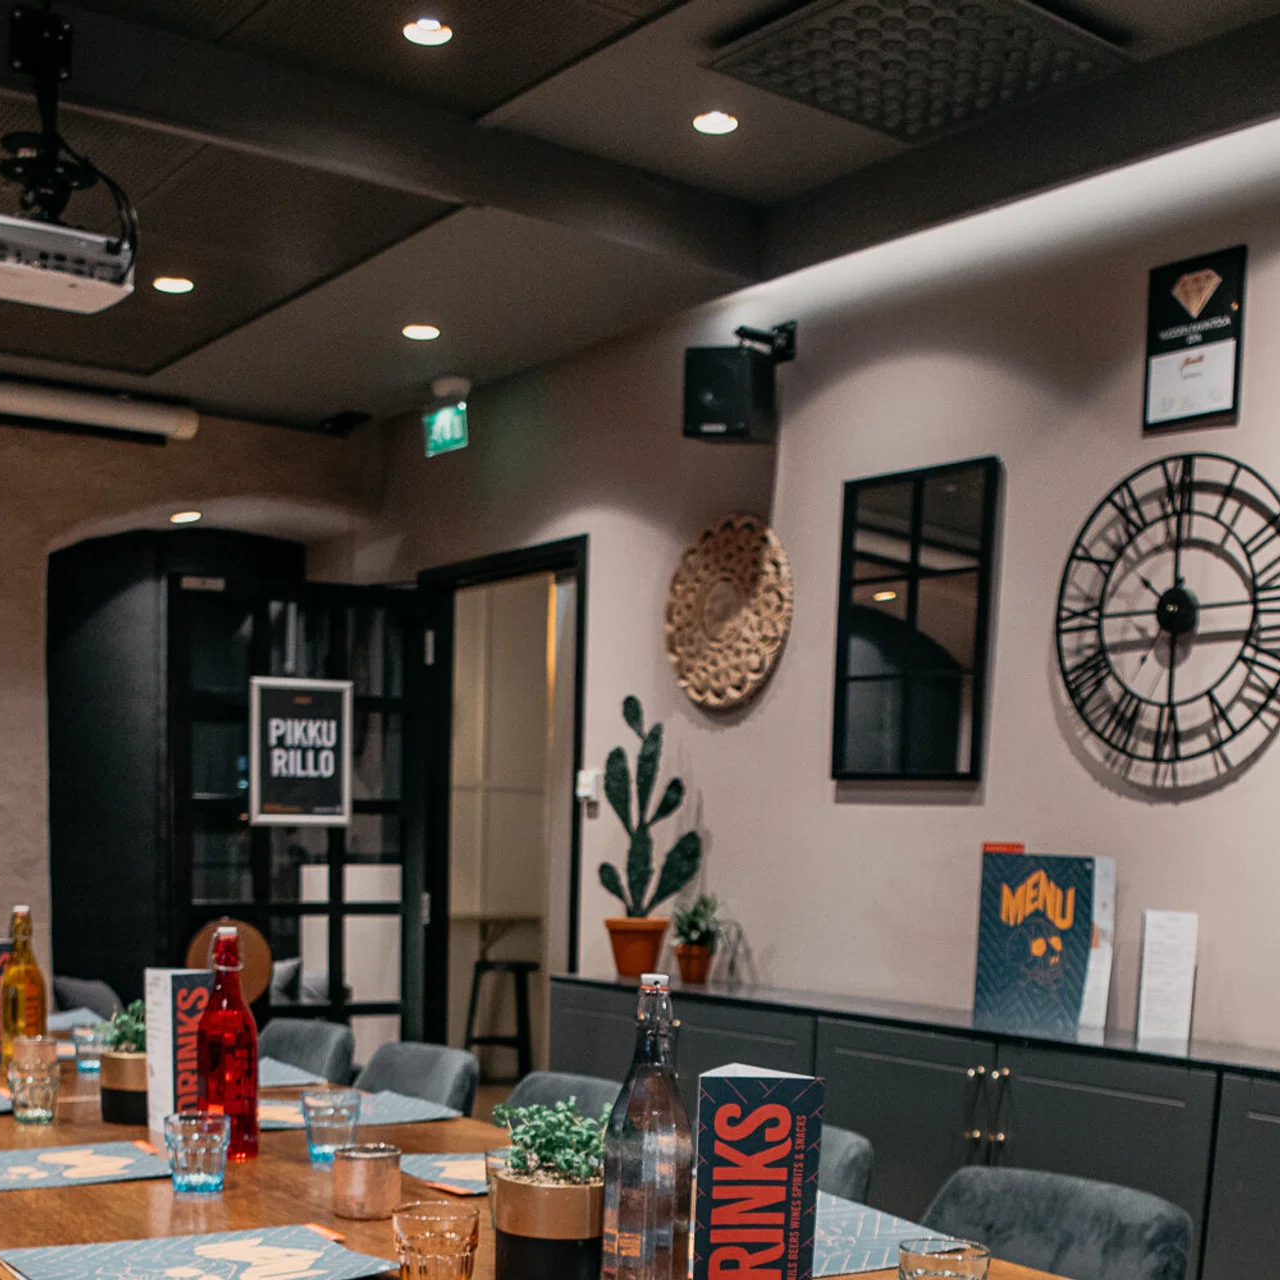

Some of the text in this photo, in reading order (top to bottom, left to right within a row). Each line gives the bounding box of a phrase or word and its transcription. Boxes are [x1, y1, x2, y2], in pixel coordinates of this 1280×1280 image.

[268, 717, 337, 747] PIKKU
[271, 748, 335, 779] RILLO
[999, 868, 1076, 930] MENU
[794, 1114, 808, 1150] SNACKS
[791, 1162, 805, 1198] SPIRITS
[789, 1200, 802, 1229] WINES
[787, 1231, 800, 1260] BEERS
